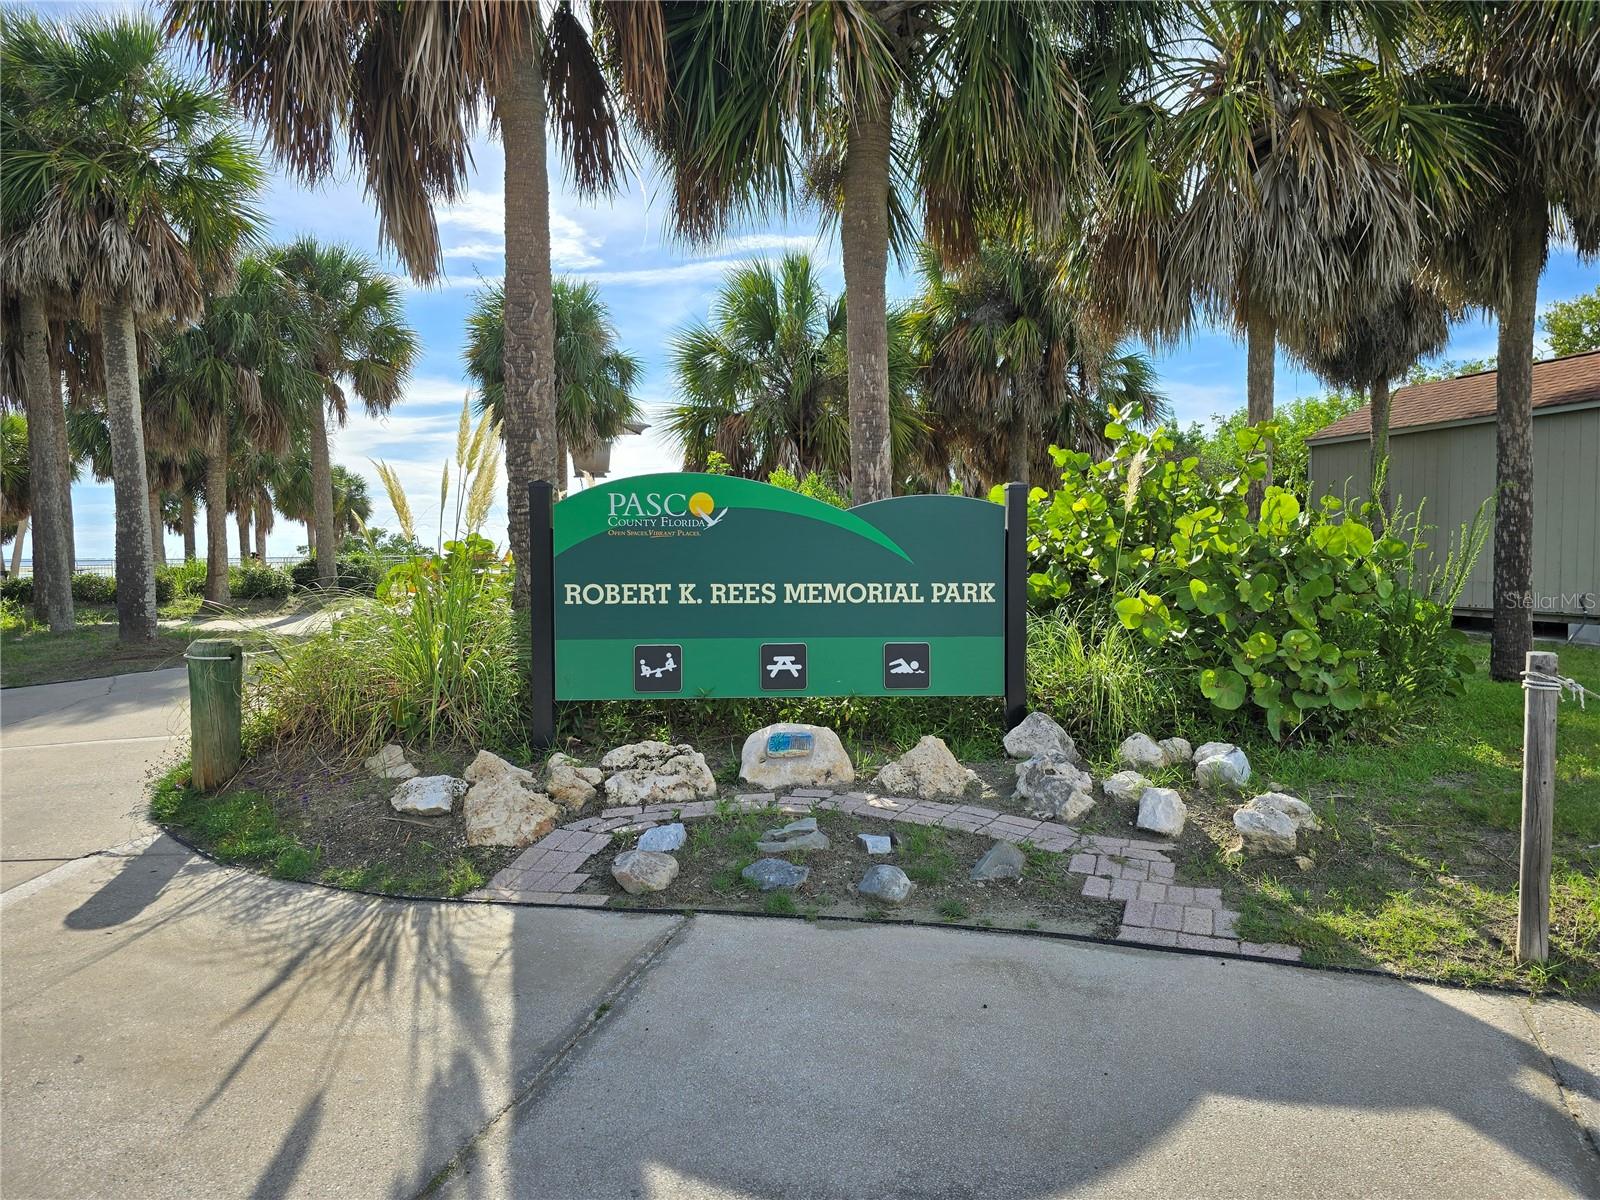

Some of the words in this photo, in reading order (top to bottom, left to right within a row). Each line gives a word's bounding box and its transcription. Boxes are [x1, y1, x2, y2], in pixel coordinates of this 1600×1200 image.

[607, 492, 715, 518] PASCO
[608, 516, 657, 528] COUNTY
[661, 516, 706, 528] FLORIDA
[564, 583, 672, 605] ROBERT
[678, 583, 703, 605] K.
[710, 583, 777, 605] REES
[783, 583, 925, 604] MEMORIAL
[931, 582, 996, 603] PARK
